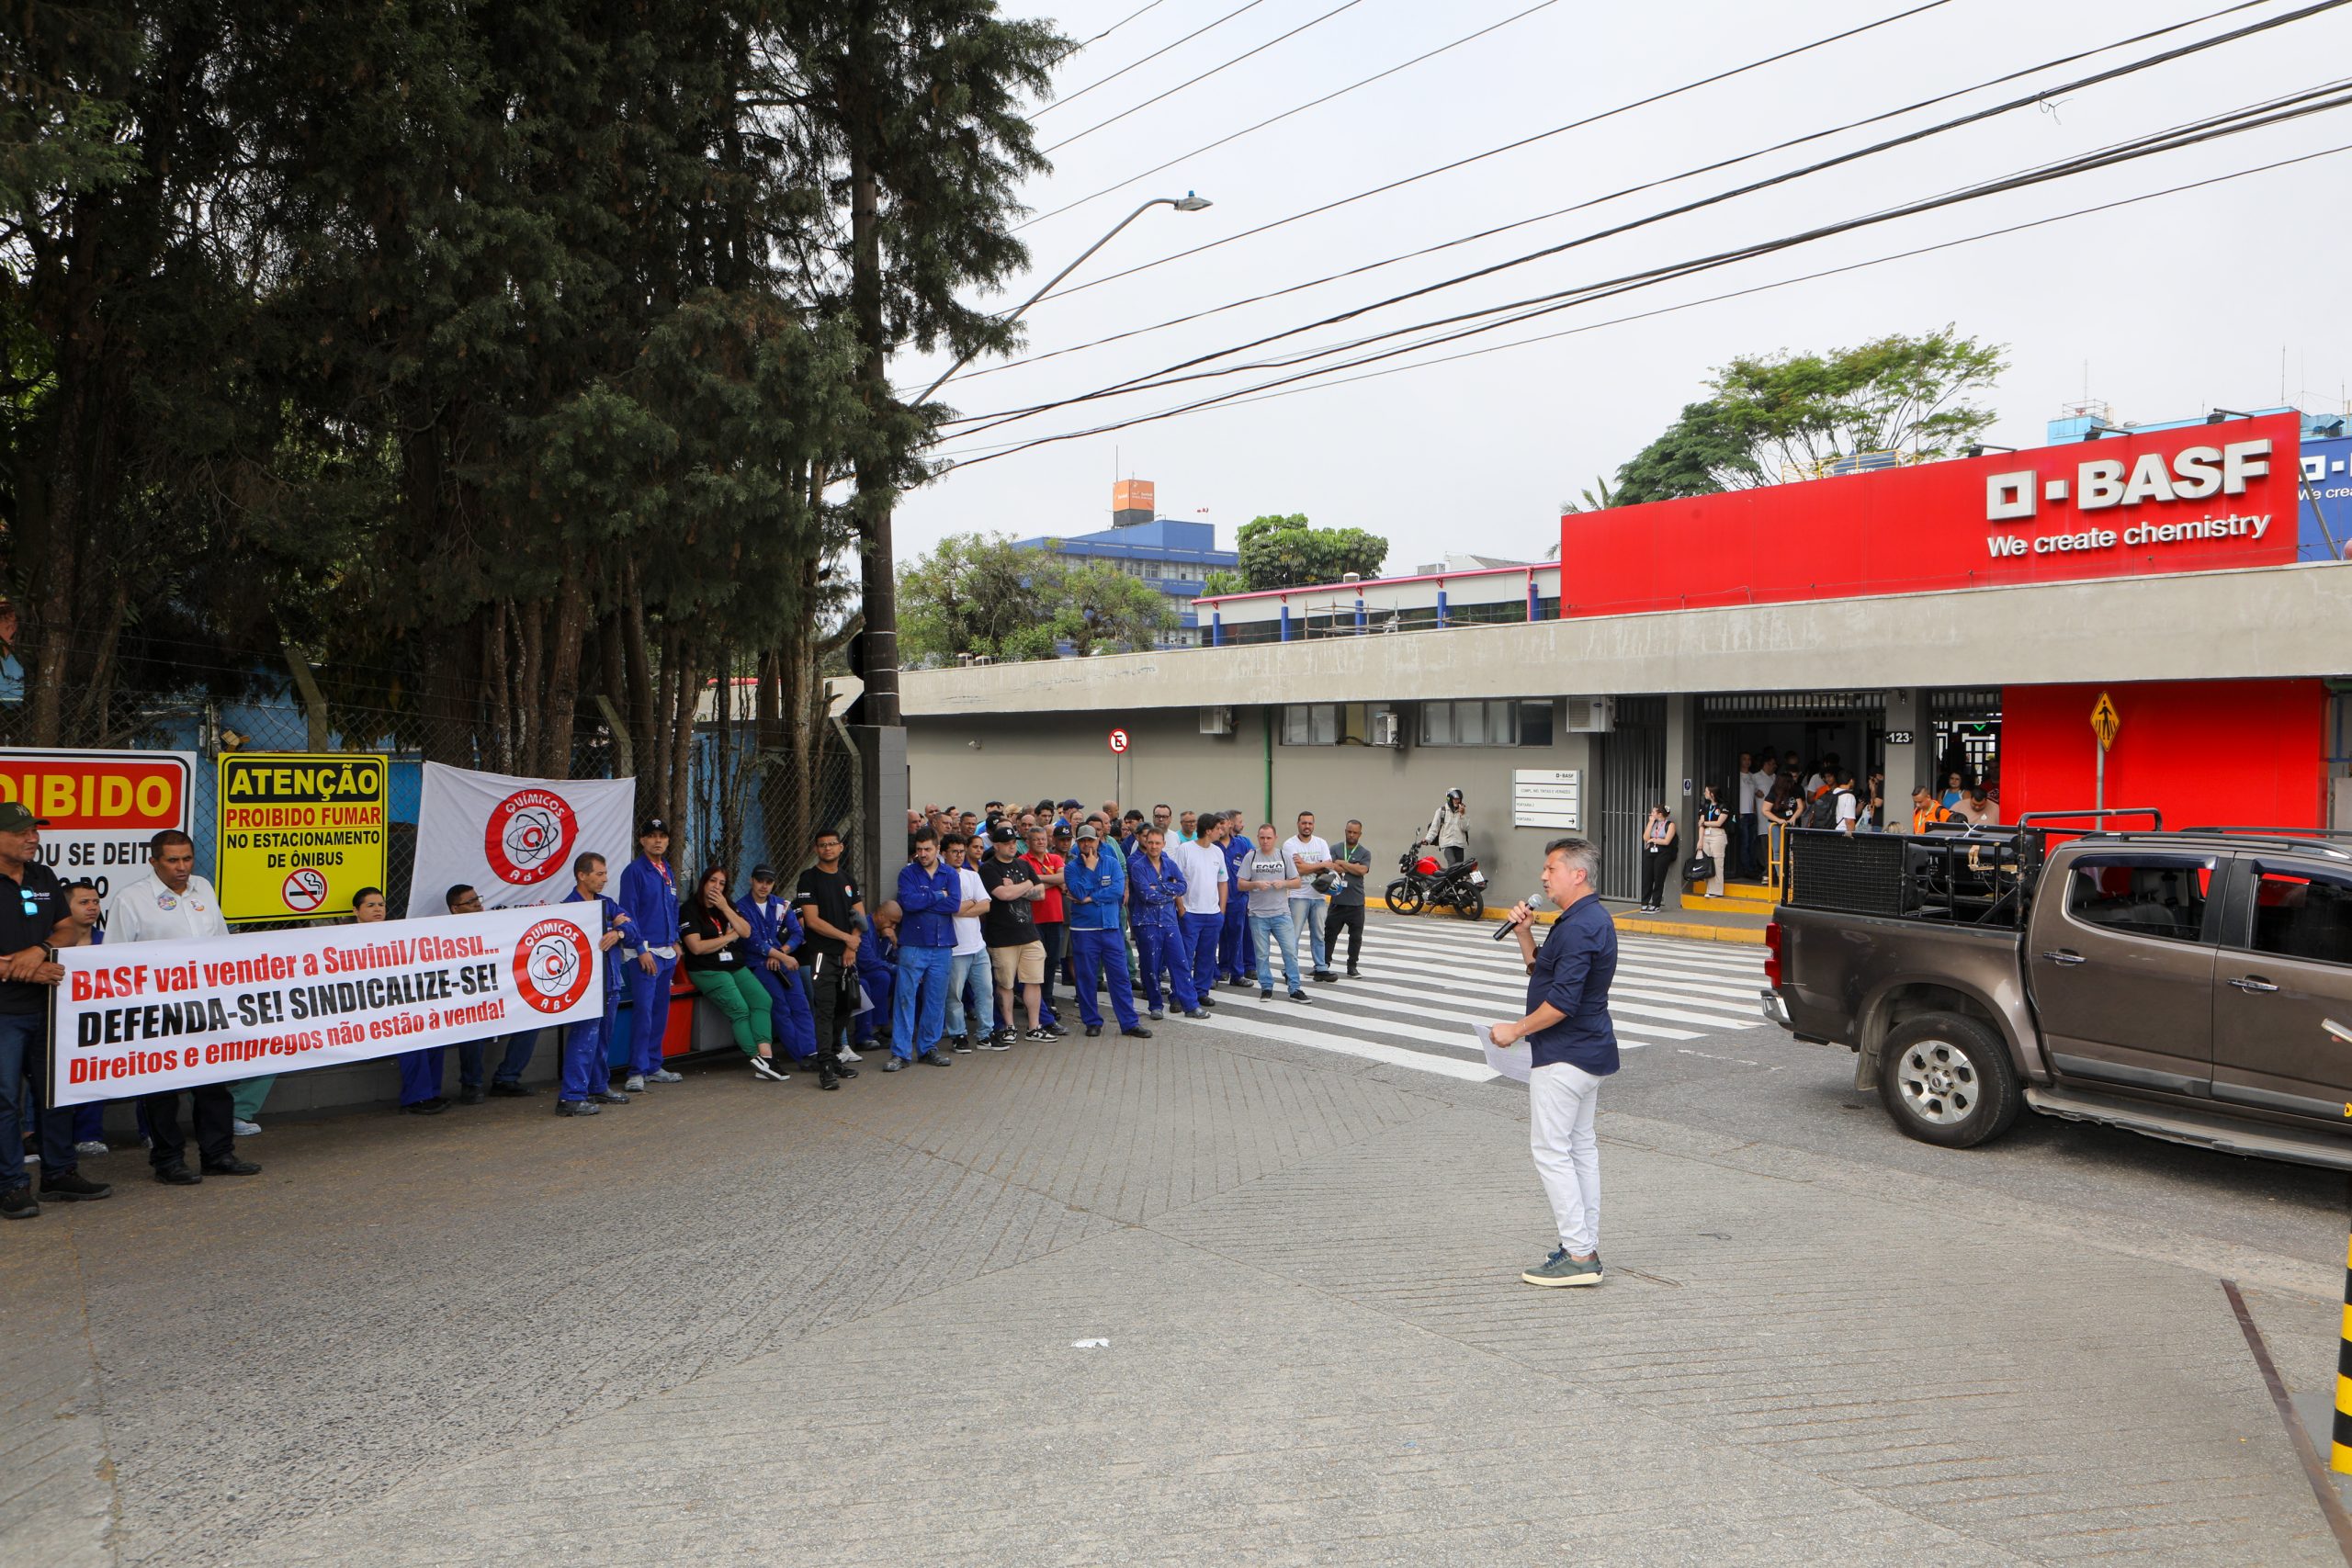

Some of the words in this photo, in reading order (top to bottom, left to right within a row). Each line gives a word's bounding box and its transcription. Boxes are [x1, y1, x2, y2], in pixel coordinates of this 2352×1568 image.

[2078, 439, 2272, 509] BASF
[1987, 536, 2028, 558] We
[2034, 527, 2117, 554] create
[2123, 514, 2272, 545] chemistry
[1889, 732, 1910, 743] 123
[230, 763, 379, 802] ATENÇÃO
[226, 807, 315, 828] PROIBIDO
[322, 807, 381, 826] FUMAR
[505, 792, 565, 818] QUÍMICOS
[227, 833, 248, 849] NO
[253, 830, 379, 848] ESTACIONAMENTO
[68, 842, 96, 866] SE
[103, 841, 152, 865] DEIT
[267, 853, 286, 868] DE
[290, 850, 344, 868] ÔNIBUS
[525, 922, 579, 947] QUÍMICOS
[71, 964, 148, 1002] BASF
[153, 960, 198, 993] vai
[203, 953, 298, 988] vender
[302, 953, 319, 981] a
[78, 990, 285, 1048] DEFENDA-SE!
[288, 963, 499, 1021] SINDICALIZE-SE!
[69, 1050, 177, 1085] Direitos
[184, 1046, 199, 1068] e
[205, 1030, 322, 1066] empregos
[326, 1021, 366, 1047] não
[369, 1010, 424, 1040] estão
[428, 1008, 440, 1031] à
[444, 998, 505, 1028] venda!
